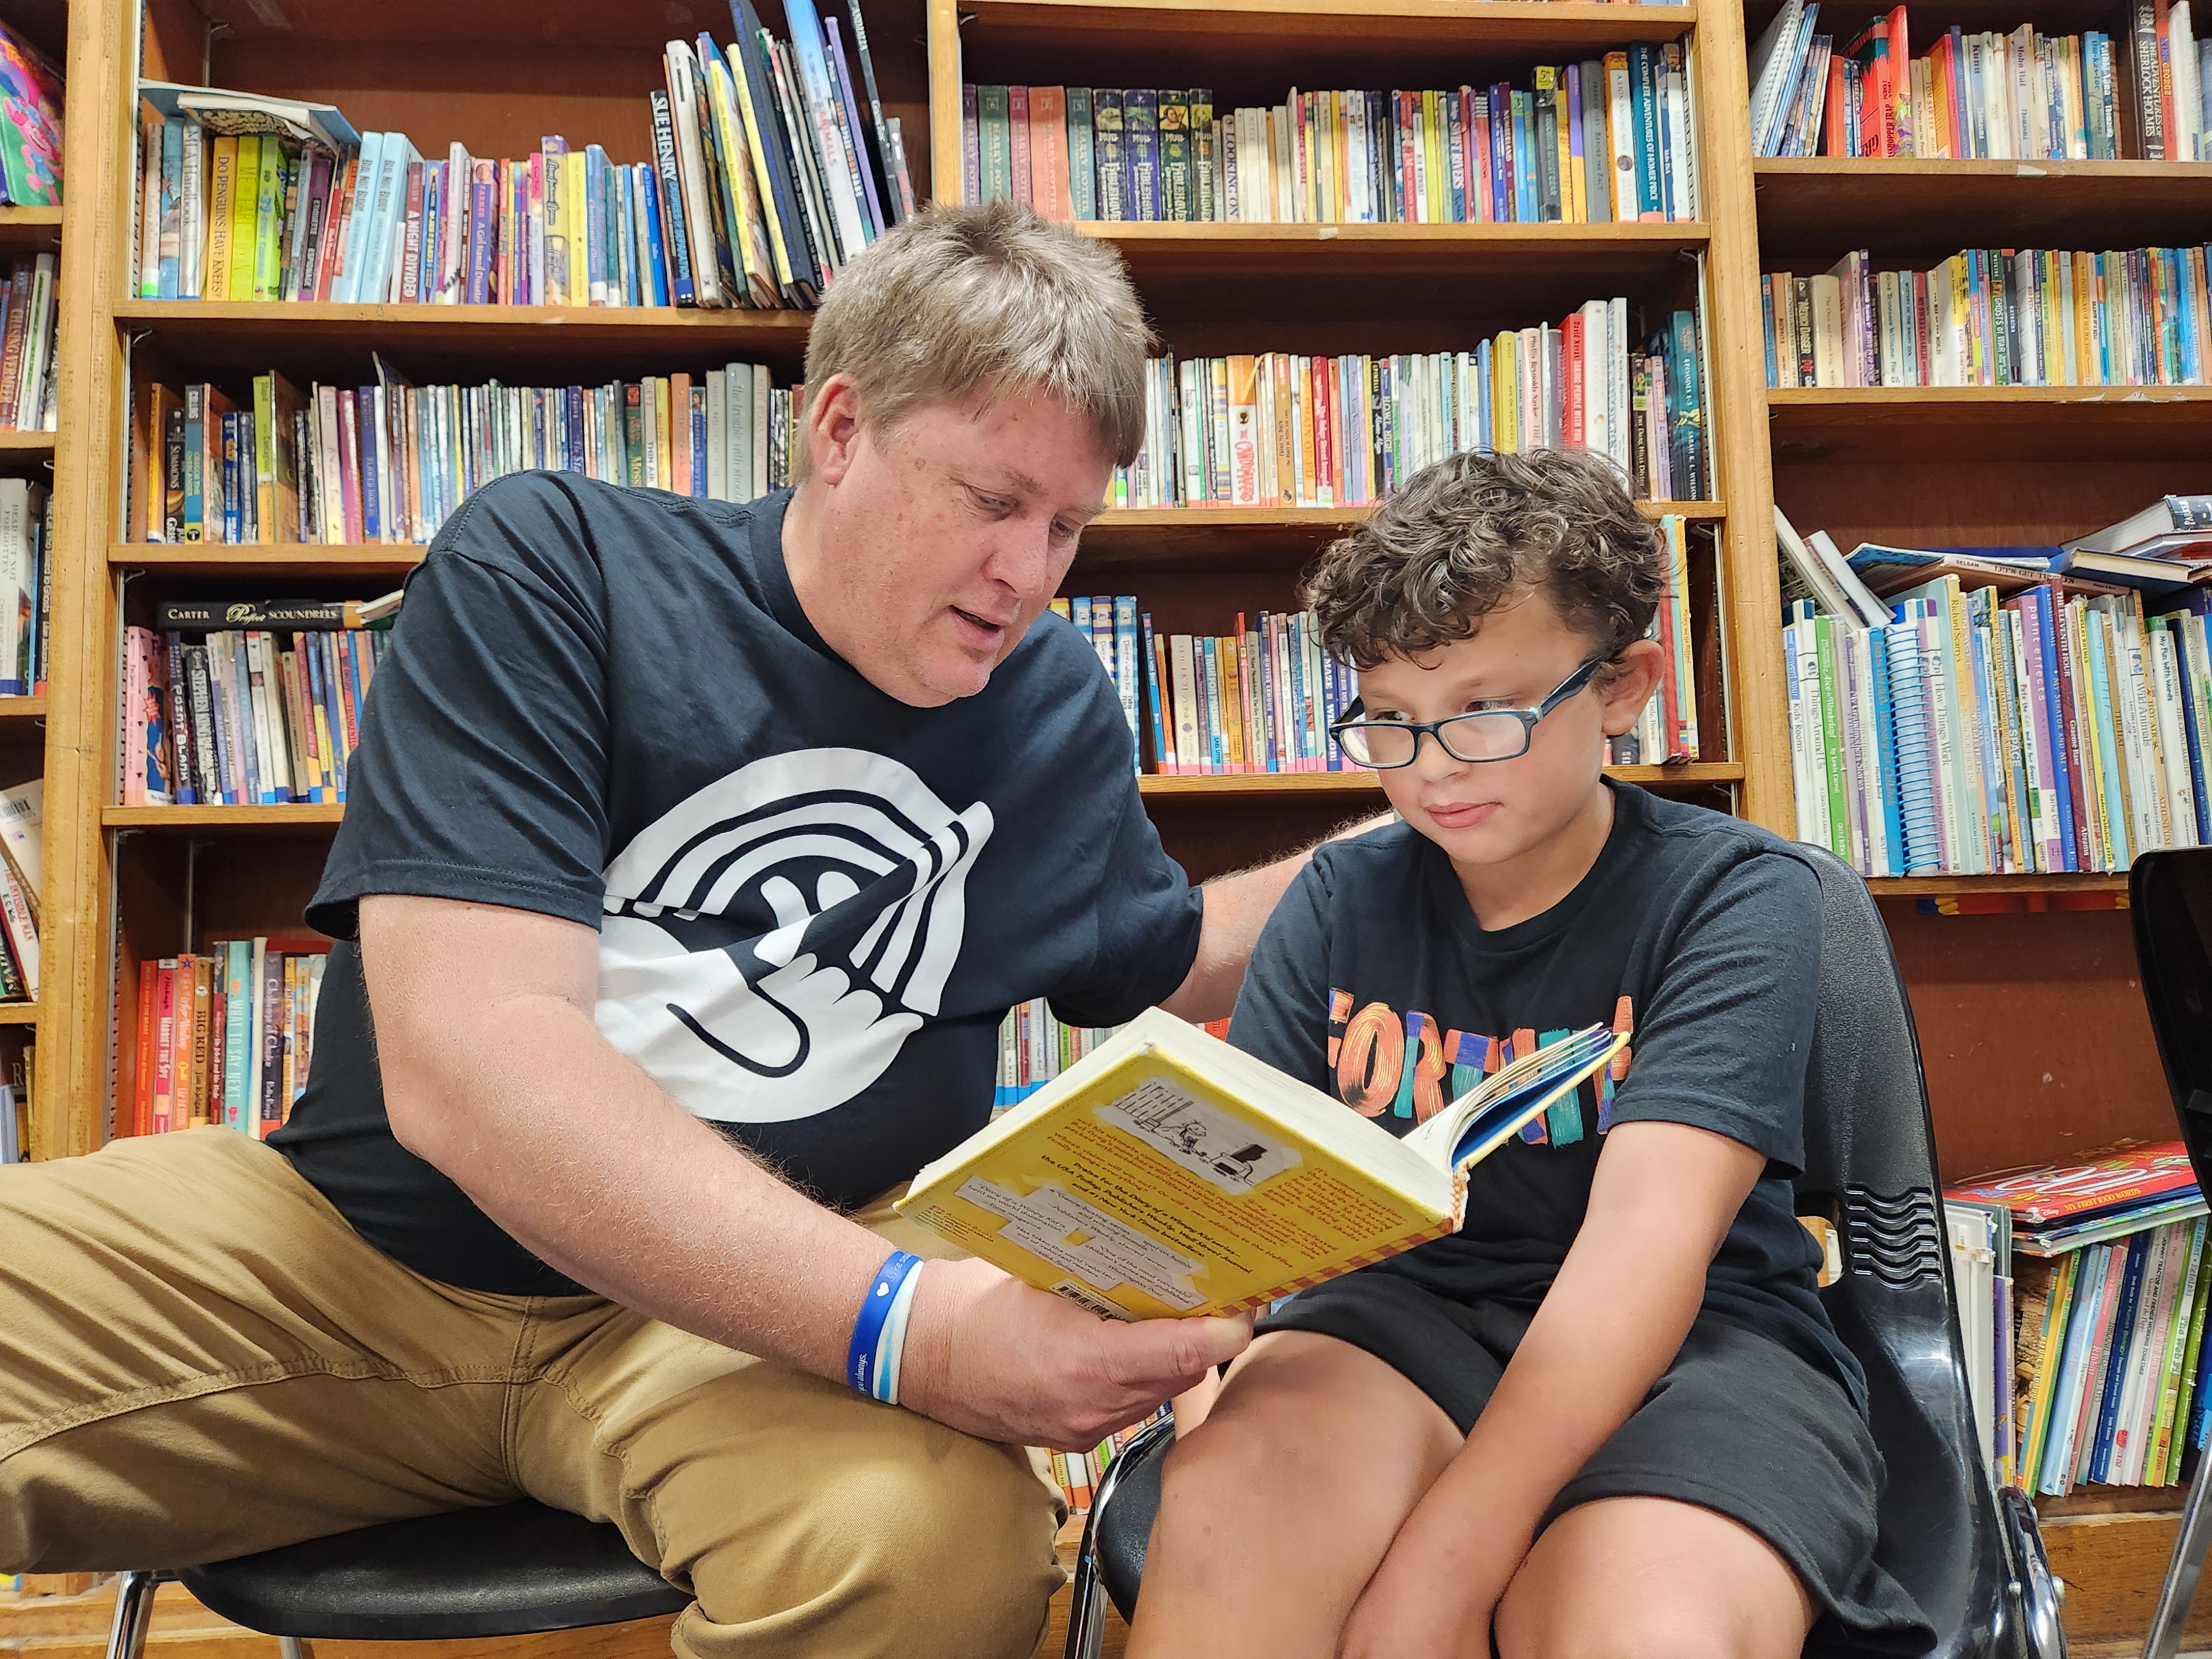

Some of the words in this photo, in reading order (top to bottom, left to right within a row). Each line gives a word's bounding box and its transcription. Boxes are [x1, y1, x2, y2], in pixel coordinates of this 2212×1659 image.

[2160, 37, 2169, 61] KING
[1640, 62, 1650, 97] COMPLETE
[2138, 40, 2152, 96] SHERLOCK
[2162, 62, 2172, 96] GEORGE
[654, 96, 670, 125] SUE
[1644, 97, 1655, 142] ADVENTURES
[2143, 96, 2155, 138] HOLMES
[656, 128, 678, 181] HENRY
[993, 123, 1003, 166] HARRY
[1018, 123, 1027, 166] HARRY
[1047, 123, 1057, 166] HARRY
[1079, 125, 1089, 167] HARRY
[1646, 143, 1655, 151] OF
[218, 156, 230, 171] DO
[1225, 132, 1239, 194] LOOKING
[1647, 152, 1656, 180] HOMER
[215, 174, 229, 227] PENGUINS
[1049, 169, 1057, 212] POTTER
[1081, 171, 1089, 213] POTTER
[1648, 181, 1658, 201] PRICE
[408, 210, 419, 219] A
[1228, 198, 1239, 216] ON
[405, 222, 419, 254] NIGHT
[477, 222, 486, 230] A
[477, 231, 487, 247] Girl
[213, 228, 226, 258] HAVE
[475, 248, 487, 268] Named
[211, 260, 224, 299] KNEES?
[403, 254, 418, 298] DIVIDED
[473, 268, 484, 304] Disaster
[1994, 298, 2004, 325] GHOSTS
[6, 307, 24, 353] CHASING
[1997, 333, 2007, 353] WAR
[0, 354, 18, 404] VERMEER
[188, 390, 200, 420] COLLINS
[1383, 395, 1391, 426] HOWL
[1385, 429, 1393, 453] HIGH
[170, 445, 181, 489] SUMMONS
[2179, 499, 2196, 527] PARKER
[1955, 559, 1980, 568] SELSAM
[1993, 565, 2017, 576] LET'S
[2019, 570, 2035, 579] GET
[167, 608, 211, 620] CARTER
[225, 603, 267, 625] Perfect
[268, 609, 338, 620] SCOUNDRELS
[1951, 599, 1960, 630] Richard
[2028, 605, 2040, 643] paint
[2136, 602, 2146, 647] PRICEMAN
[2058, 607, 2069, 653] ELEVENTH
[1953, 631, 1961, 663] Scarry's
[1788, 646, 1797, 682] Reinvent
[2033, 648, 2045, 702] effects
[191, 668, 210, 713] STEPHEN
[1180, 667, 1190, 692] HOT
[1935, 682, 1945, 703] How
[2136, 682, 2145, 704] Wild
[173, 684, 185, 733] POINT
[1181, 693, 1190, 719] ZONE
[1810, 687, 1820, 717] Things
[195, 713, 212, 736] KING
[1813, 719, 1823, 753] Around
[1937, 705, 1949, 740] Things
[2069, 719, 2078, 745] Graeme
[2139, 707, 2150, 748] Animals
[175, 733, 190, 781] BLANK
[1816, 754, 1823, 770] Us
[1942, 742, 1952, 766] Work
[2159, 794, 2171, 846] ATHENEUM
[197, 1010, 206, 1033] BIG
[228, 999, 244, 1027] WHAT
[196, 1036, 206, 1064] RED
[228, 1032, 243, 1045] TO
[227, 1049, 242, 1067] SAY
[226, 1073, 242, 1099] NEXT
[966, 1185, 987, 1195] bent
[997, 1199, 1021, 1212] world
[1071, 1162, 1101, 1179] Praise
[1098, 1177, 1115, 1187] for
[1111, 1185, 1131, 1195] the
[1127, 1193, 1154, 1208] Diary
[1167, 1215, 1199, 1233] Wimpy
[1195, 1231, 1214, 1241] Kid
[1209, 1239, 1244, 1258] series—
[2064, 1202, 2075, 1213] MY
[2075, 1197, 2097, 1211] FIRST
[2098, 1193, 2114, 1204] 1000
[2114, 1187, 2141, 1202] WORDS
[1005, 1212, 1042, 1230] magazine
[1017, 1203, 1046, 1218] Wimpy
[1044, 1217, 1060, 1225] Kid
[1039, 1155, 1057, 1165] the
[1053, 1163, 1076, 1176] USA
[1073, 1174, 1104, 1191] Today,
[1100, 1189, 1146, 1214] Publishers
[1144, 1213, 1178, 1232] Weekly,
[1176, 1231, 1198, 1243] Wall
[1194, 1241, 1223, 1256] Street
[1218, 1255, 1255, 1274] Journal,
[1070, 1182, 1089, 1192] and
[1097, 1197, 1118, 1208] New
[1116, 1207, 1138, 1219] York
[1135, 1218, 1162, 1232] Times
[1159, 1231, 1207, 1257] bestsellers:
[1088, 1225, 1117, 1241] Weekly,
[1116, 1241, 1145, 1256] starred
[1142, 1255, 1170, 1270] review
[2192, 1222, 2206, 1257] Palatini
[1138, 1268, 1157, 1279] most
[1155, 1278, 1193, 1298] successful
[2186, 1264, 2198, 1297] Egielski
[2179, 1316, 2188, 1335] The
[2039, 1334, 2048, 1361] BEFORE
[2174, 1336, 2185, 1360] Web
[855, 1353, 868, 1383] always.
[2030, 1360, 2044, 1404] COLUMBUS
